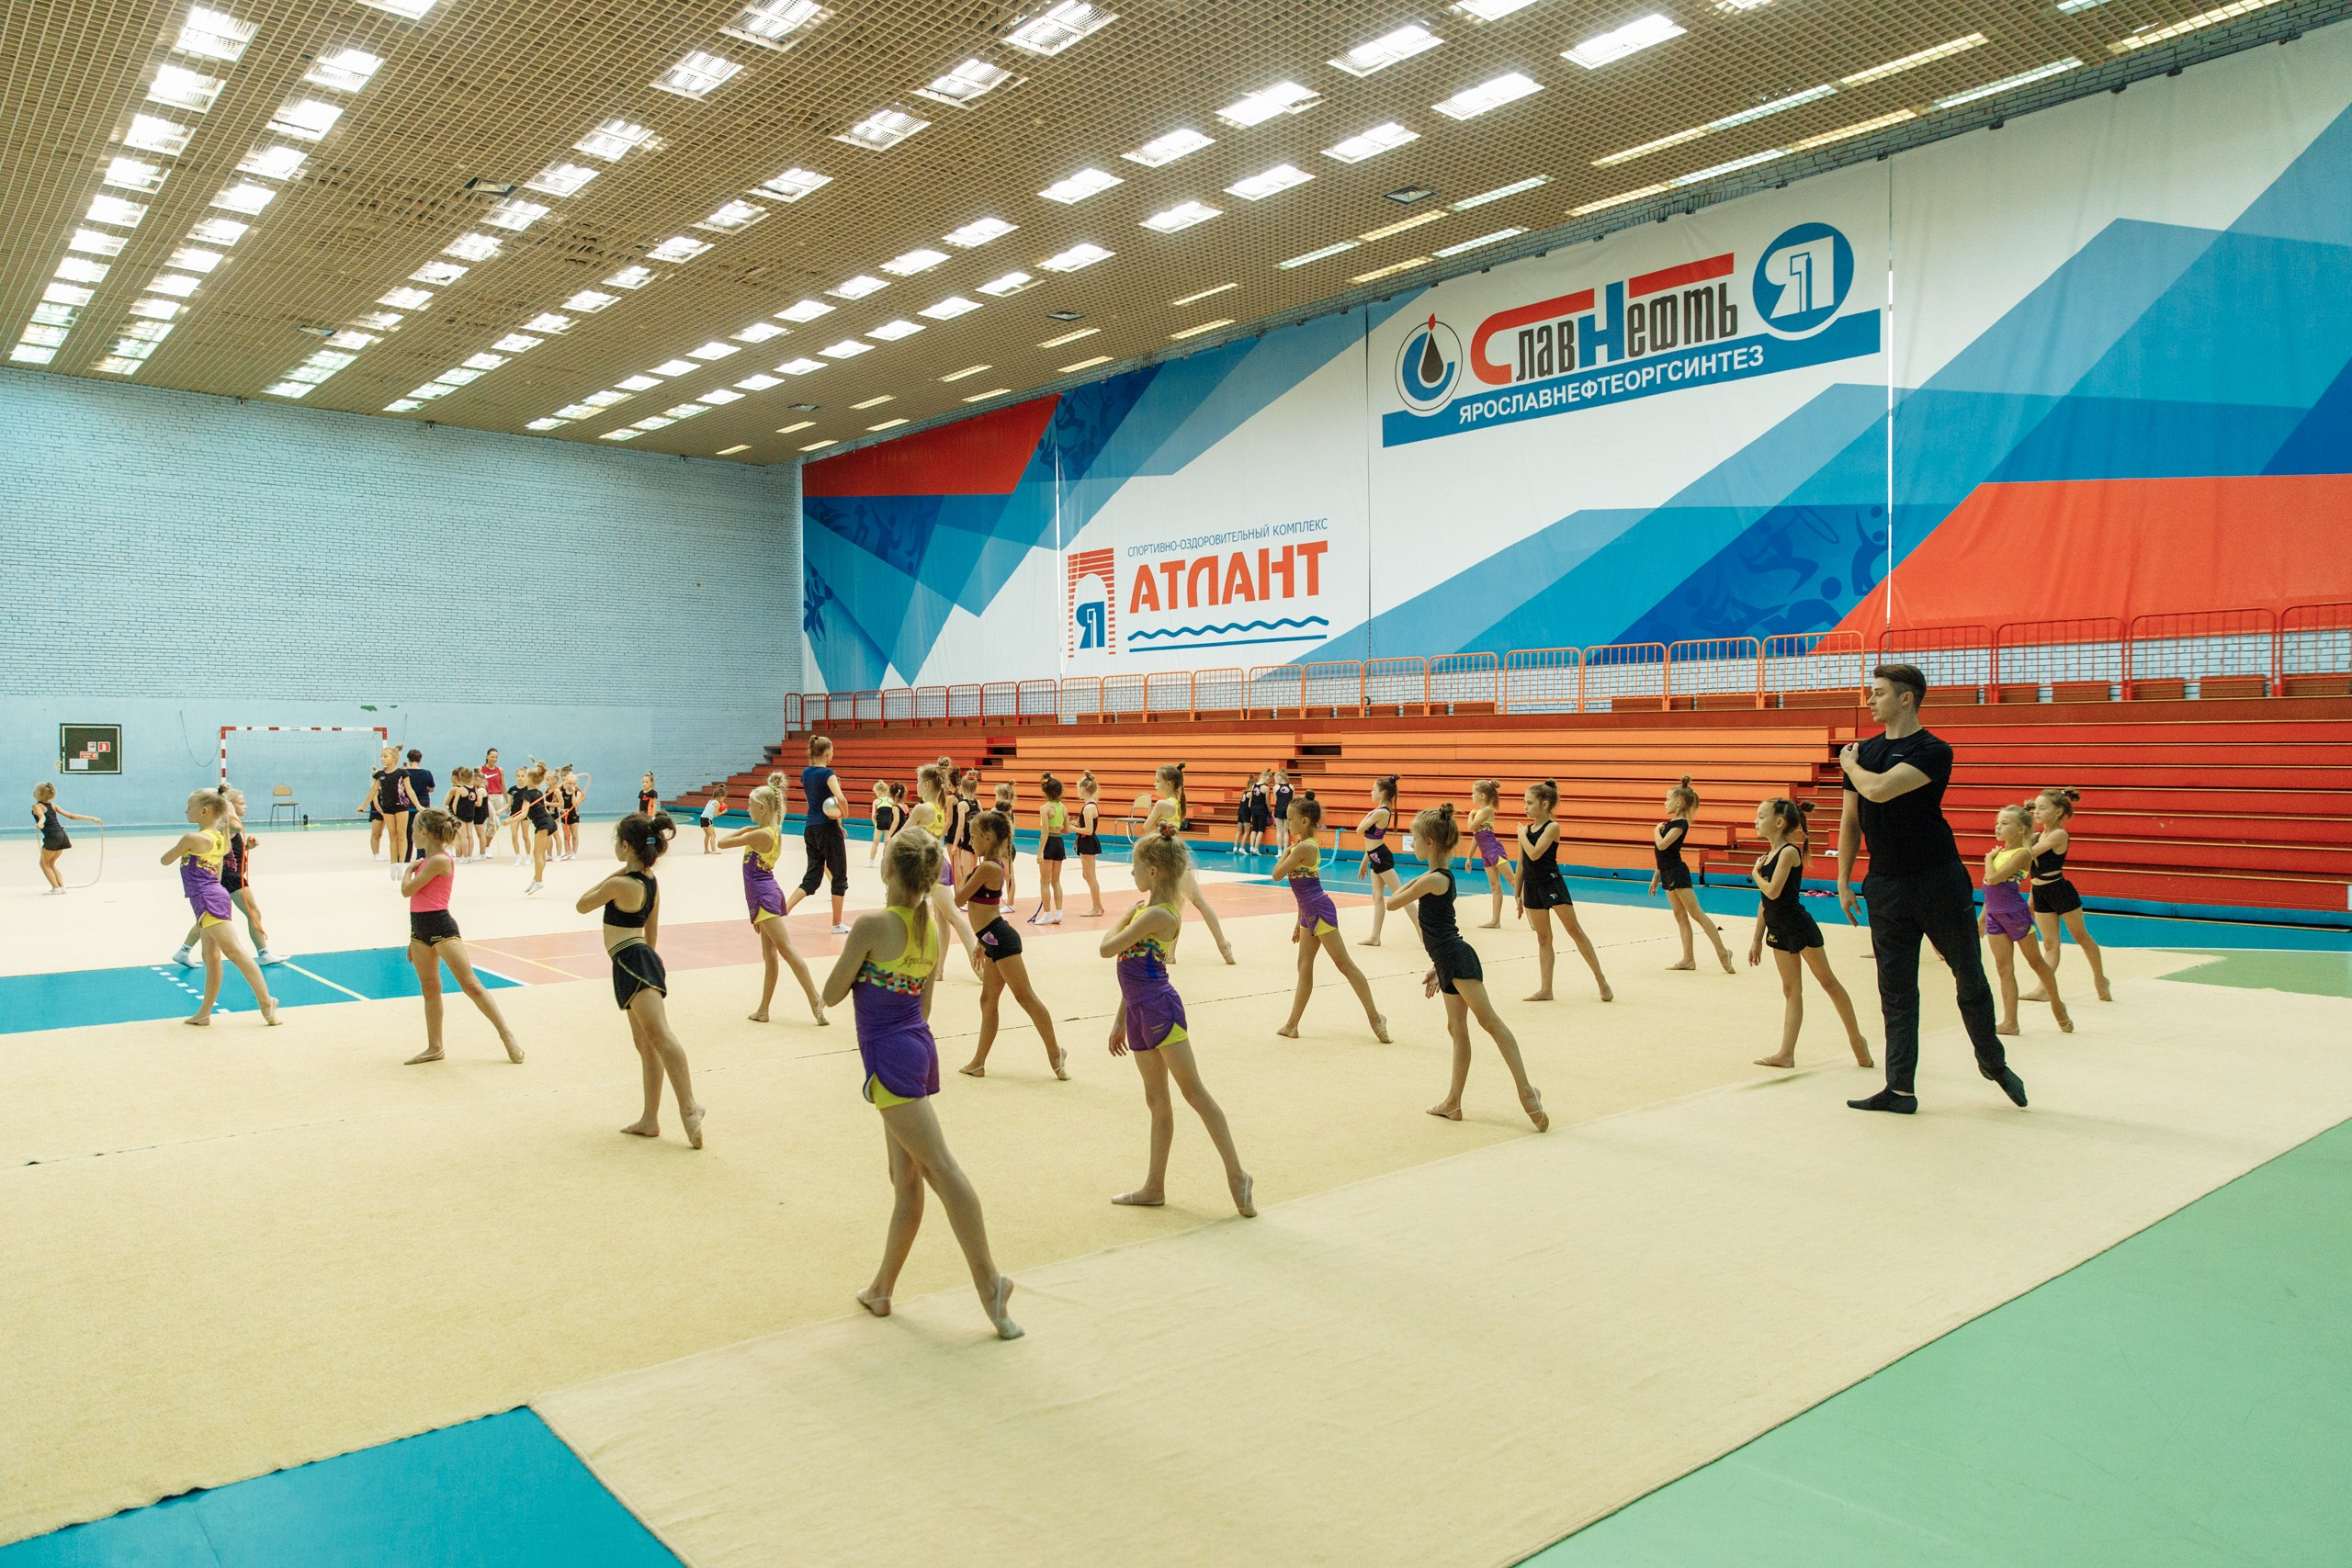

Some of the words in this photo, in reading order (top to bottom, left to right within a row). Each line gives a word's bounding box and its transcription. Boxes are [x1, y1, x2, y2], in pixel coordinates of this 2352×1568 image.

[1459, 345, 1764, 424] ЯРОСЛАВНЕФТЕОРГСИНТЕЗ
[1127, 524, 1270, 558] СПОРТИВНО-ОЗДОРОВИТЕЛЬНЫЙ
[1272, 517, 1329, 537] КОМПЛЕКС
[1129, 540, 1329, 614] АТЛАНТ
